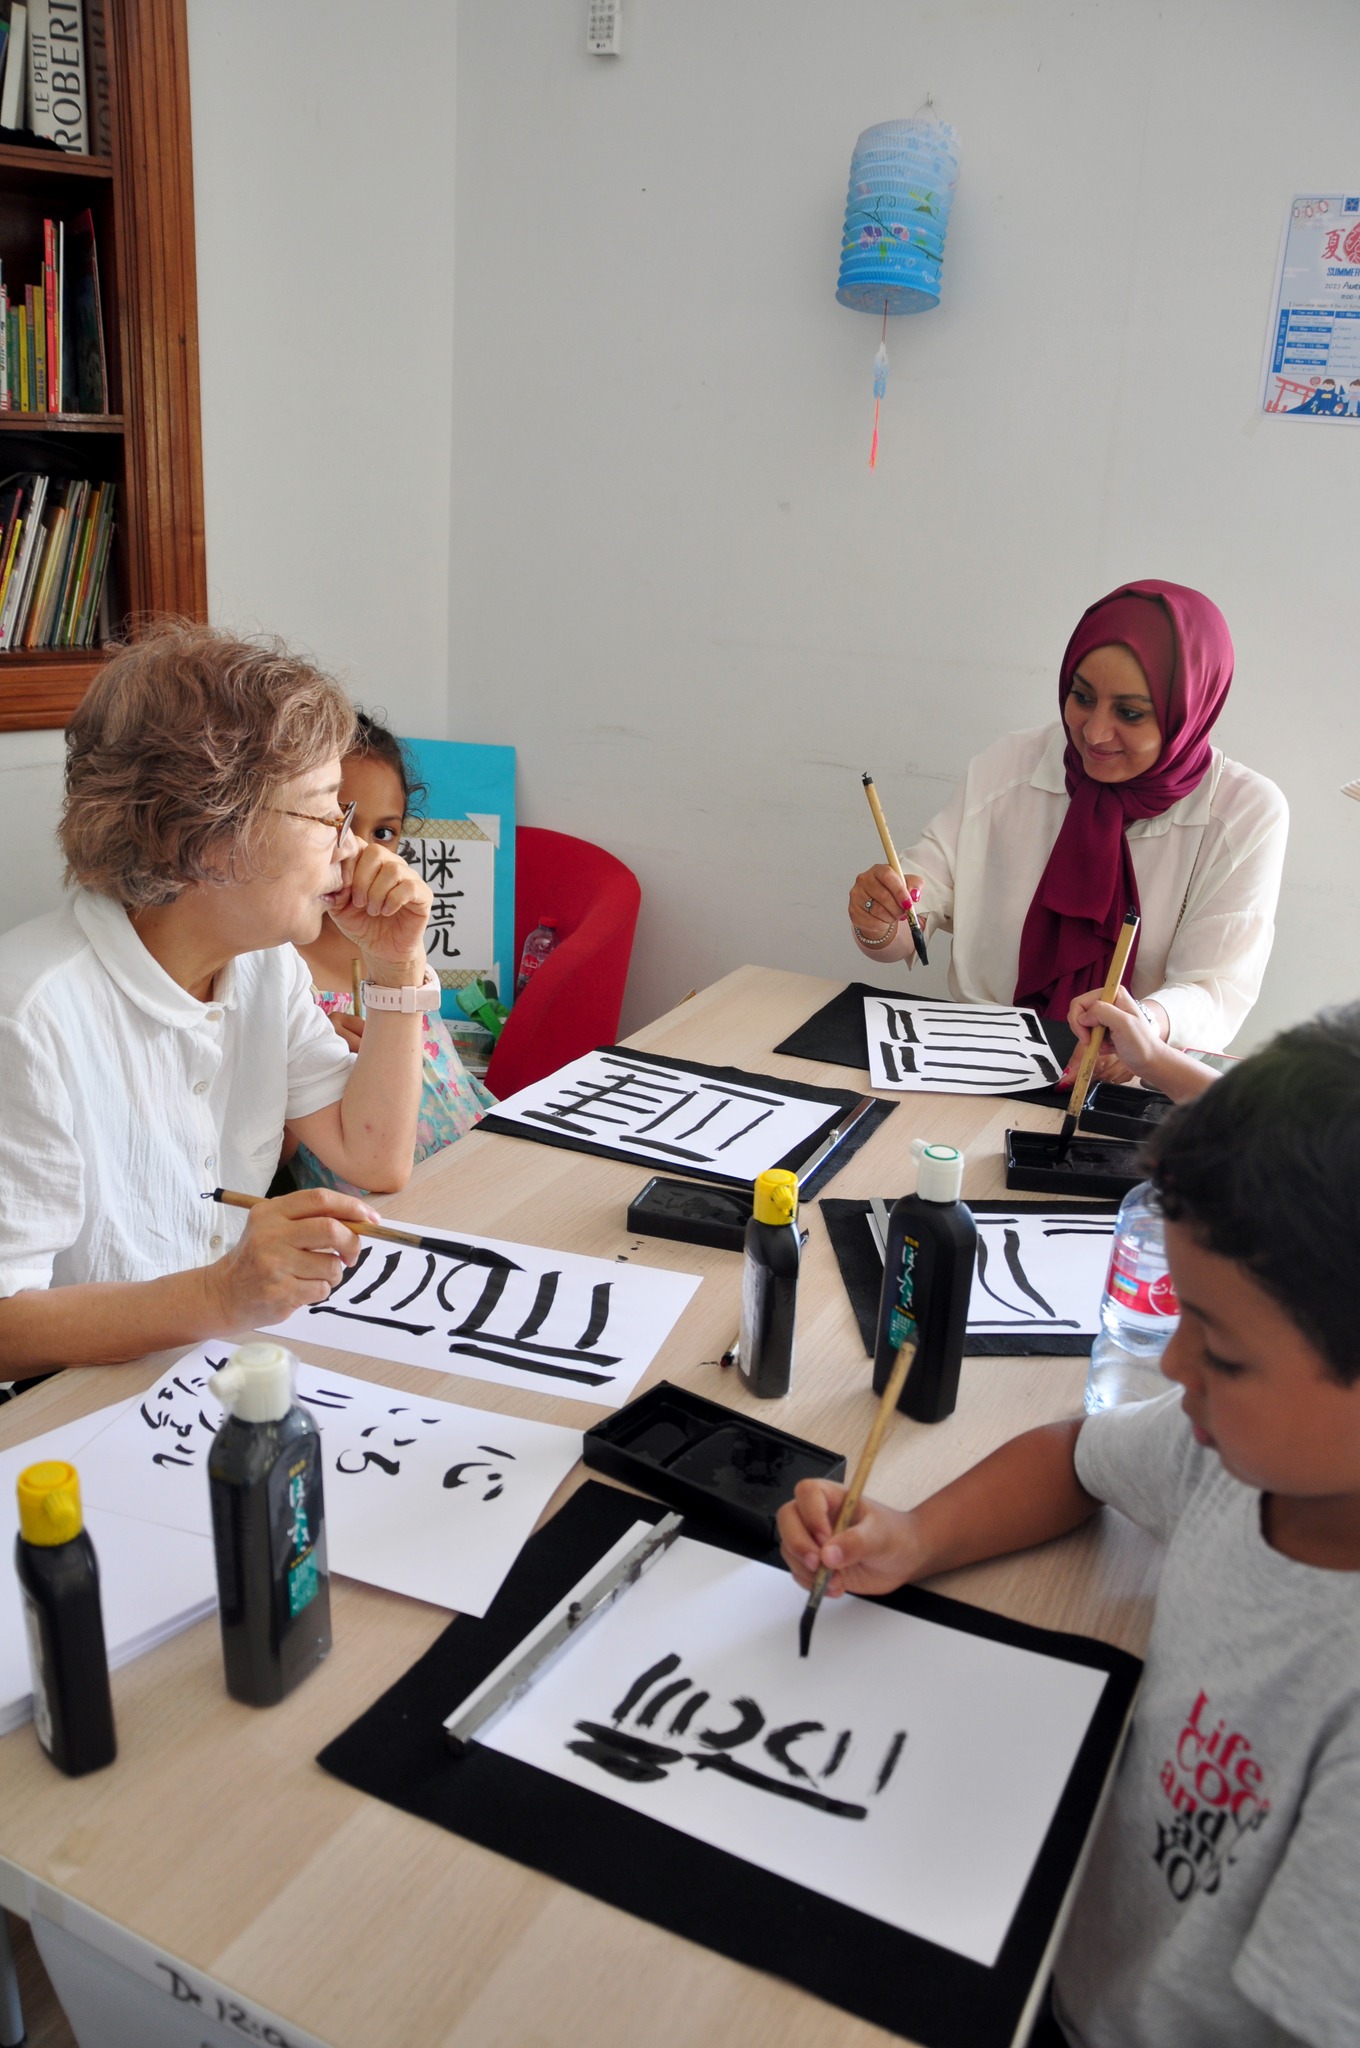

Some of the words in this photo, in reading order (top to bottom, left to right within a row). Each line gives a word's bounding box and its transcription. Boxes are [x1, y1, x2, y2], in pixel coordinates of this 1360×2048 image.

[32, 33, 49, 84] PETIT
[48, 0, 83, 153] ROBERT
[35, 95, 50, 114] LE
